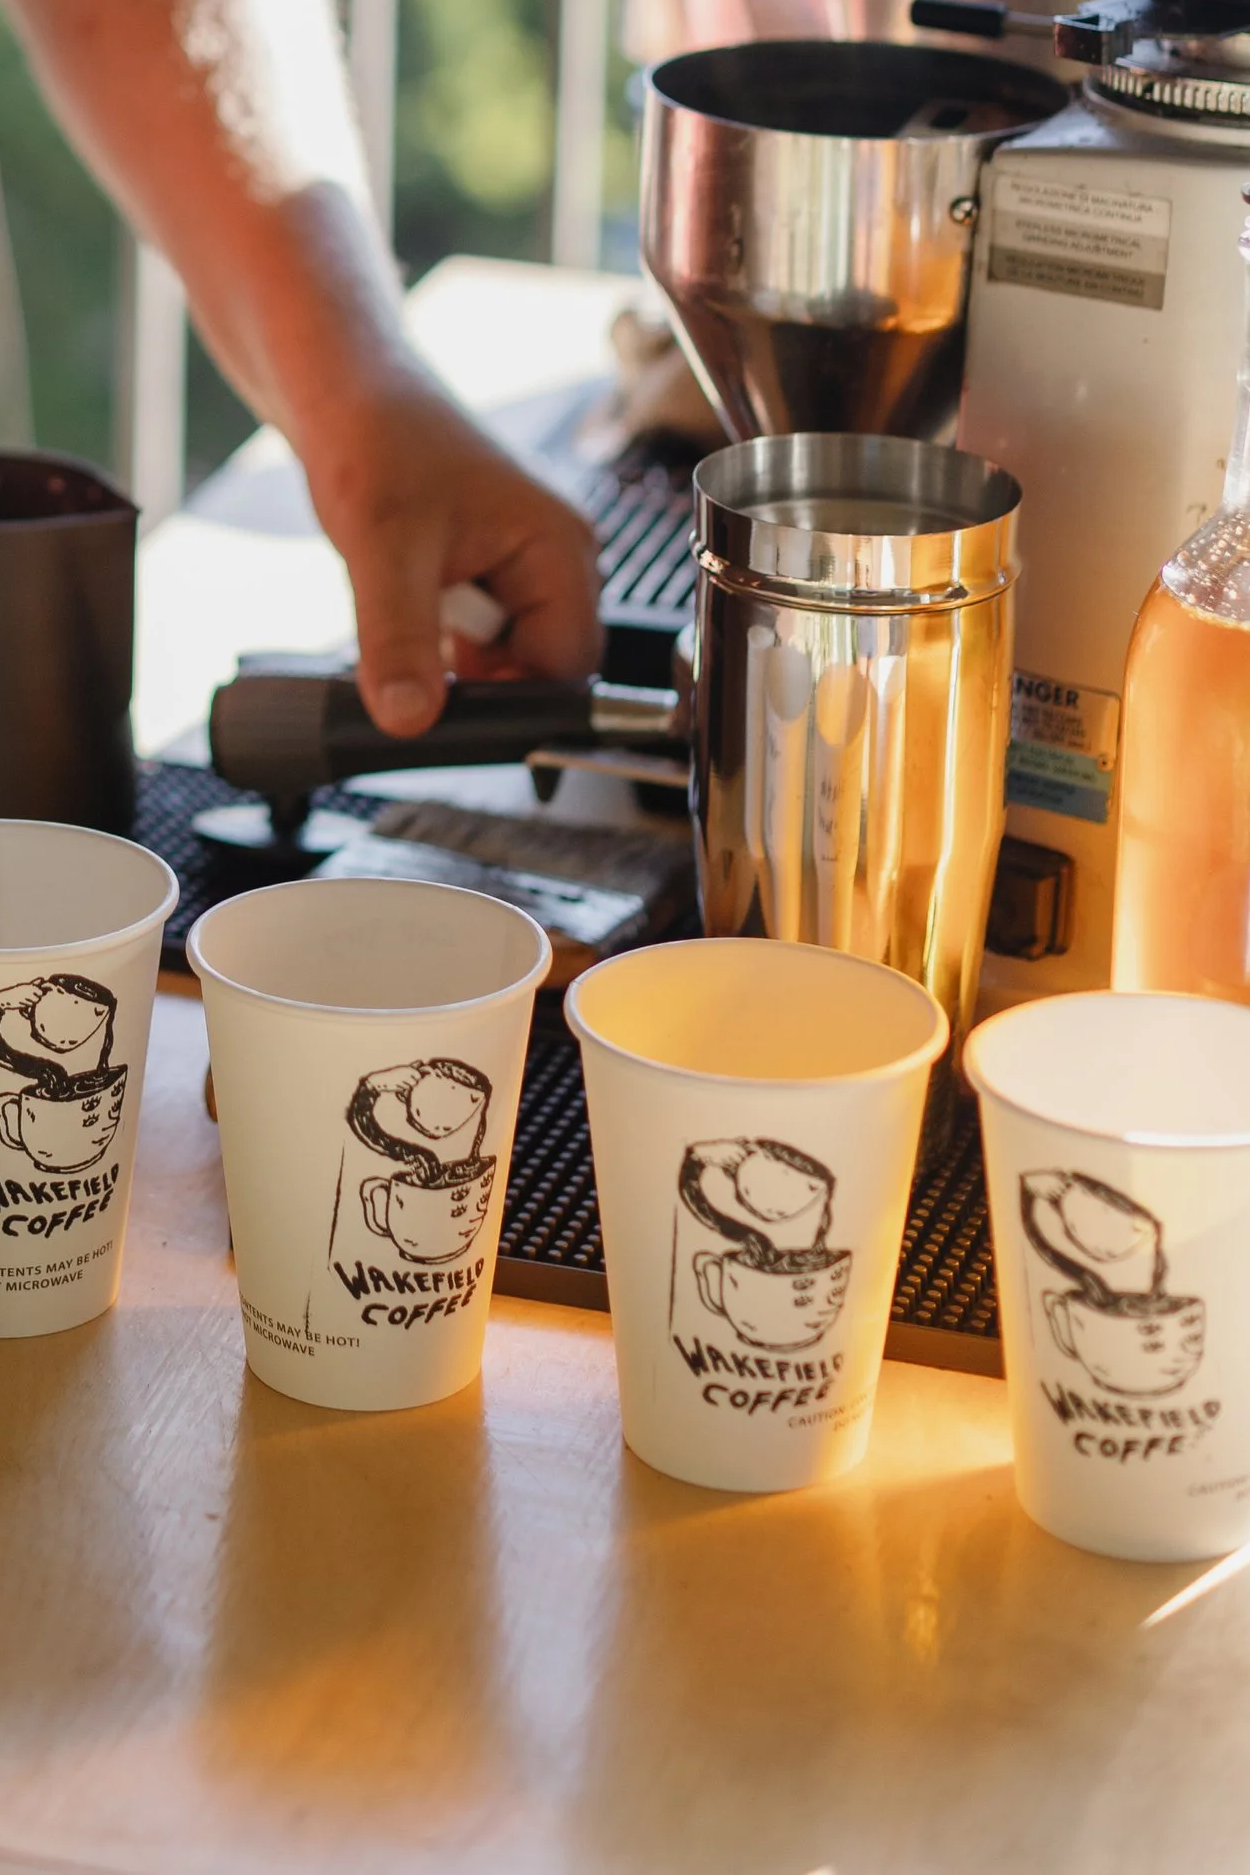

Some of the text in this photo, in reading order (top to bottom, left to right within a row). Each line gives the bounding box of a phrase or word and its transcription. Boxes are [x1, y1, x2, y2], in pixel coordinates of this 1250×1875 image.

[1016, 676, 1080, 710] NGER
[2, 1188, 114, 1239] COFFEE
[46, 1258, 74, 1274] MAY
[76, 1253, 90, 1265] BE
[92, 1240, 114, 1259] HOT!
[6, 1269, 84, 1292] MICROWAVE
[333, 1257, 485, 1301] WAKEFIELD
[361, 1283, 477, 1331] COFFEE
[253, 1319, 316, 1357] MICROWAVE
[276, 1321, 302, 1339] MAY
[305, 1330, 322, 1344] BE
[326, 1335, 361, 1349] HOT!
[672, 1333, 845, 1382] WAKEFIELD
[702, 1377, 835, 1418] COFFEE
[1039, 1377, 1222, 1429] WAKEFIELD
